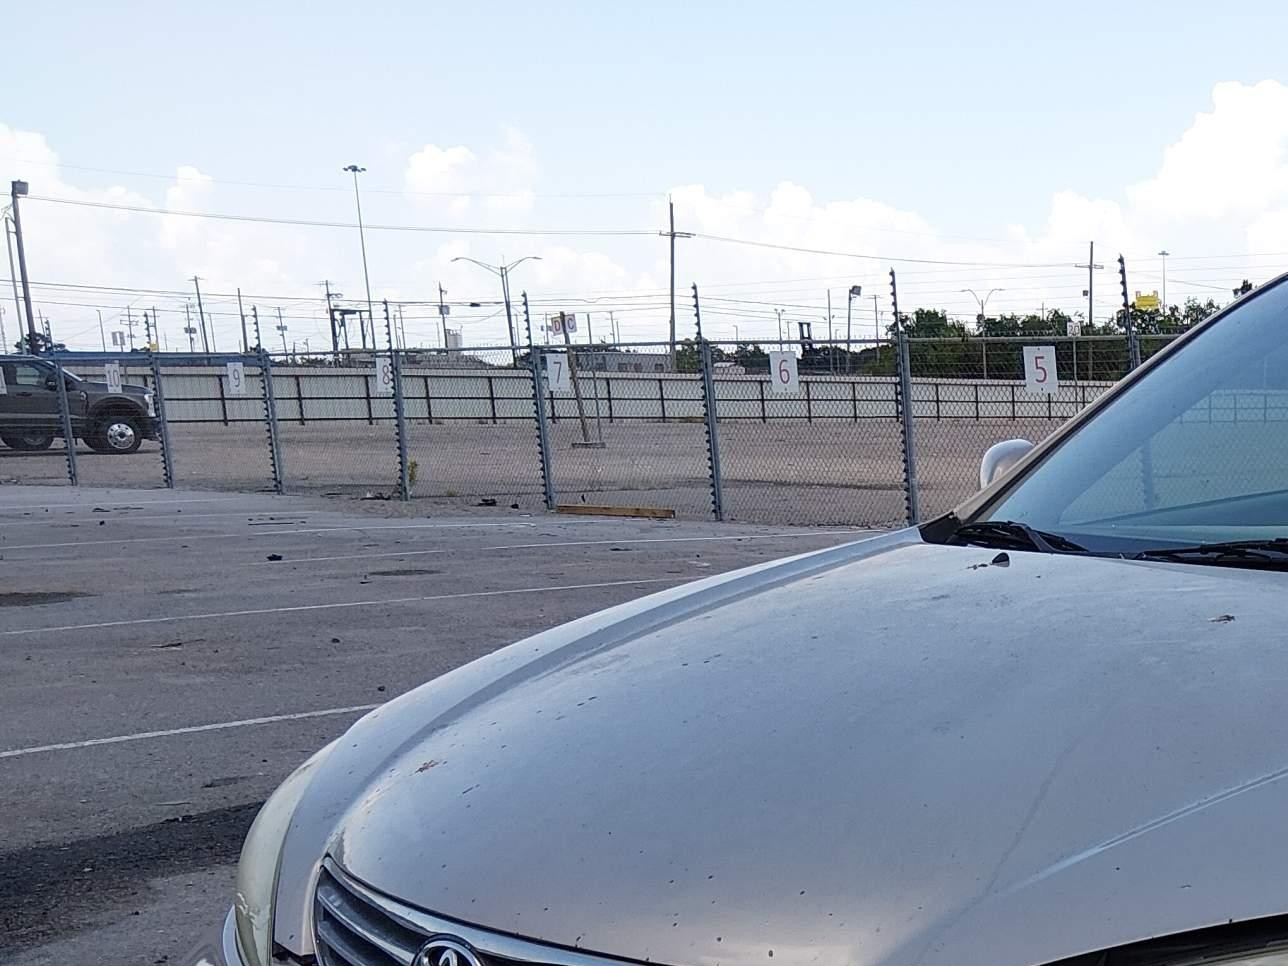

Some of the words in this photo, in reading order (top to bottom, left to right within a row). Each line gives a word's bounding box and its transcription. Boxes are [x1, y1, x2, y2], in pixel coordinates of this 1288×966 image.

[567, 317, 575, 330] C
[106, 369, 120, 388] 10
[232, 368, 241, 388] 9
[382, 364, 390, 386] 8
[552, 360, 562, 385] 7
[778, 359, 791, 385] 6
[1034, 355, 1048, 384] 5
